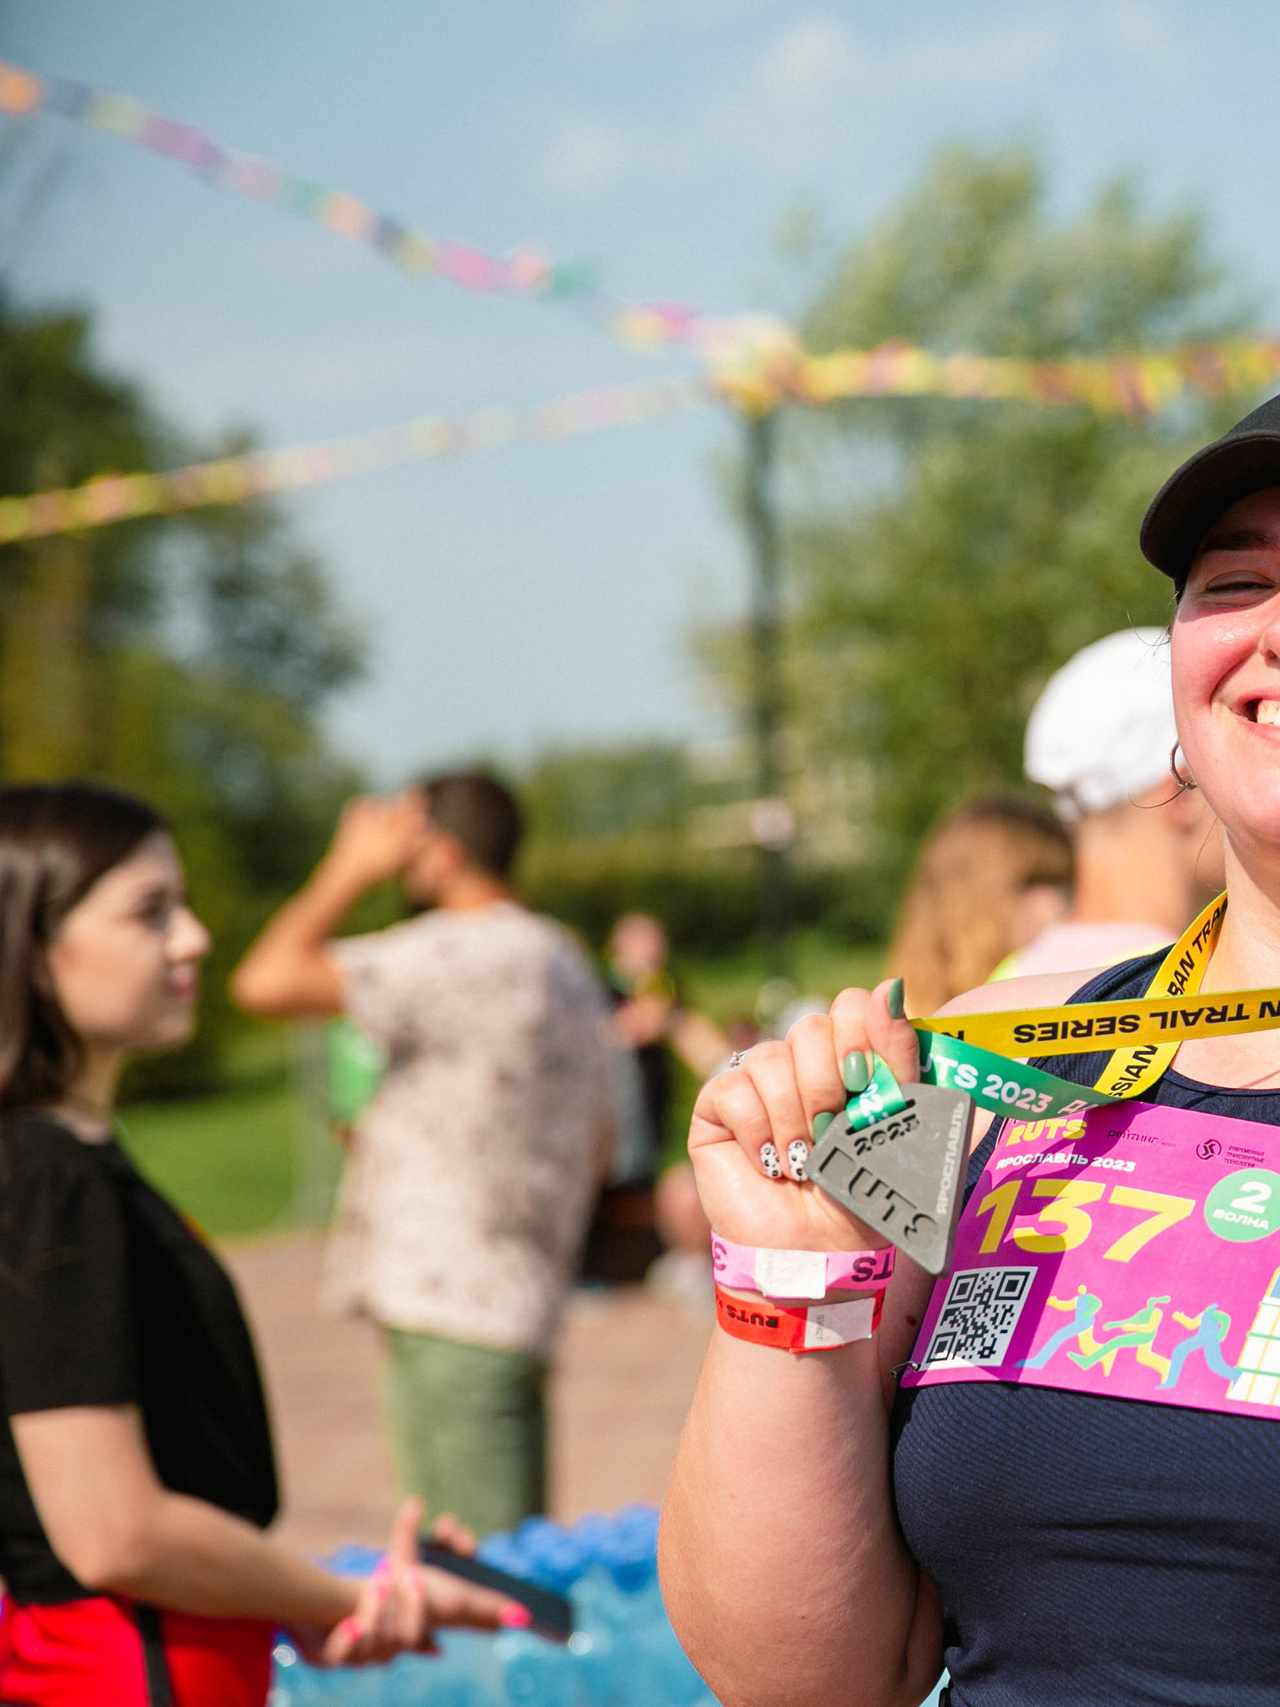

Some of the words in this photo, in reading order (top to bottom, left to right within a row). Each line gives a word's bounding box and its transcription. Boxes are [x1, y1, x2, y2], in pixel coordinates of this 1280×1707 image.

[1014, 1014, 1141, 1043] SERIES
[1149, 1003, 1250, 1030] TRAIL
[981, 1074, 1053, 1113] 2023
[1005, 1118, 1088, 1147] RUTS
[936, 1101, 965, 1215] ЯРОСЛАВЛЬ
[995, 1152, 1089, 1170] ЯРОСЛАВЛЬ
[1091, 1156, 1137, 1172] 2023
[1230, 1181, 1272, 1214] 2
[976, 1178, 1197, 1263] 137
[1212, 1208, 1269, 1230] ВОЛНА
[727, 1304, 780, 1329] RUTS
